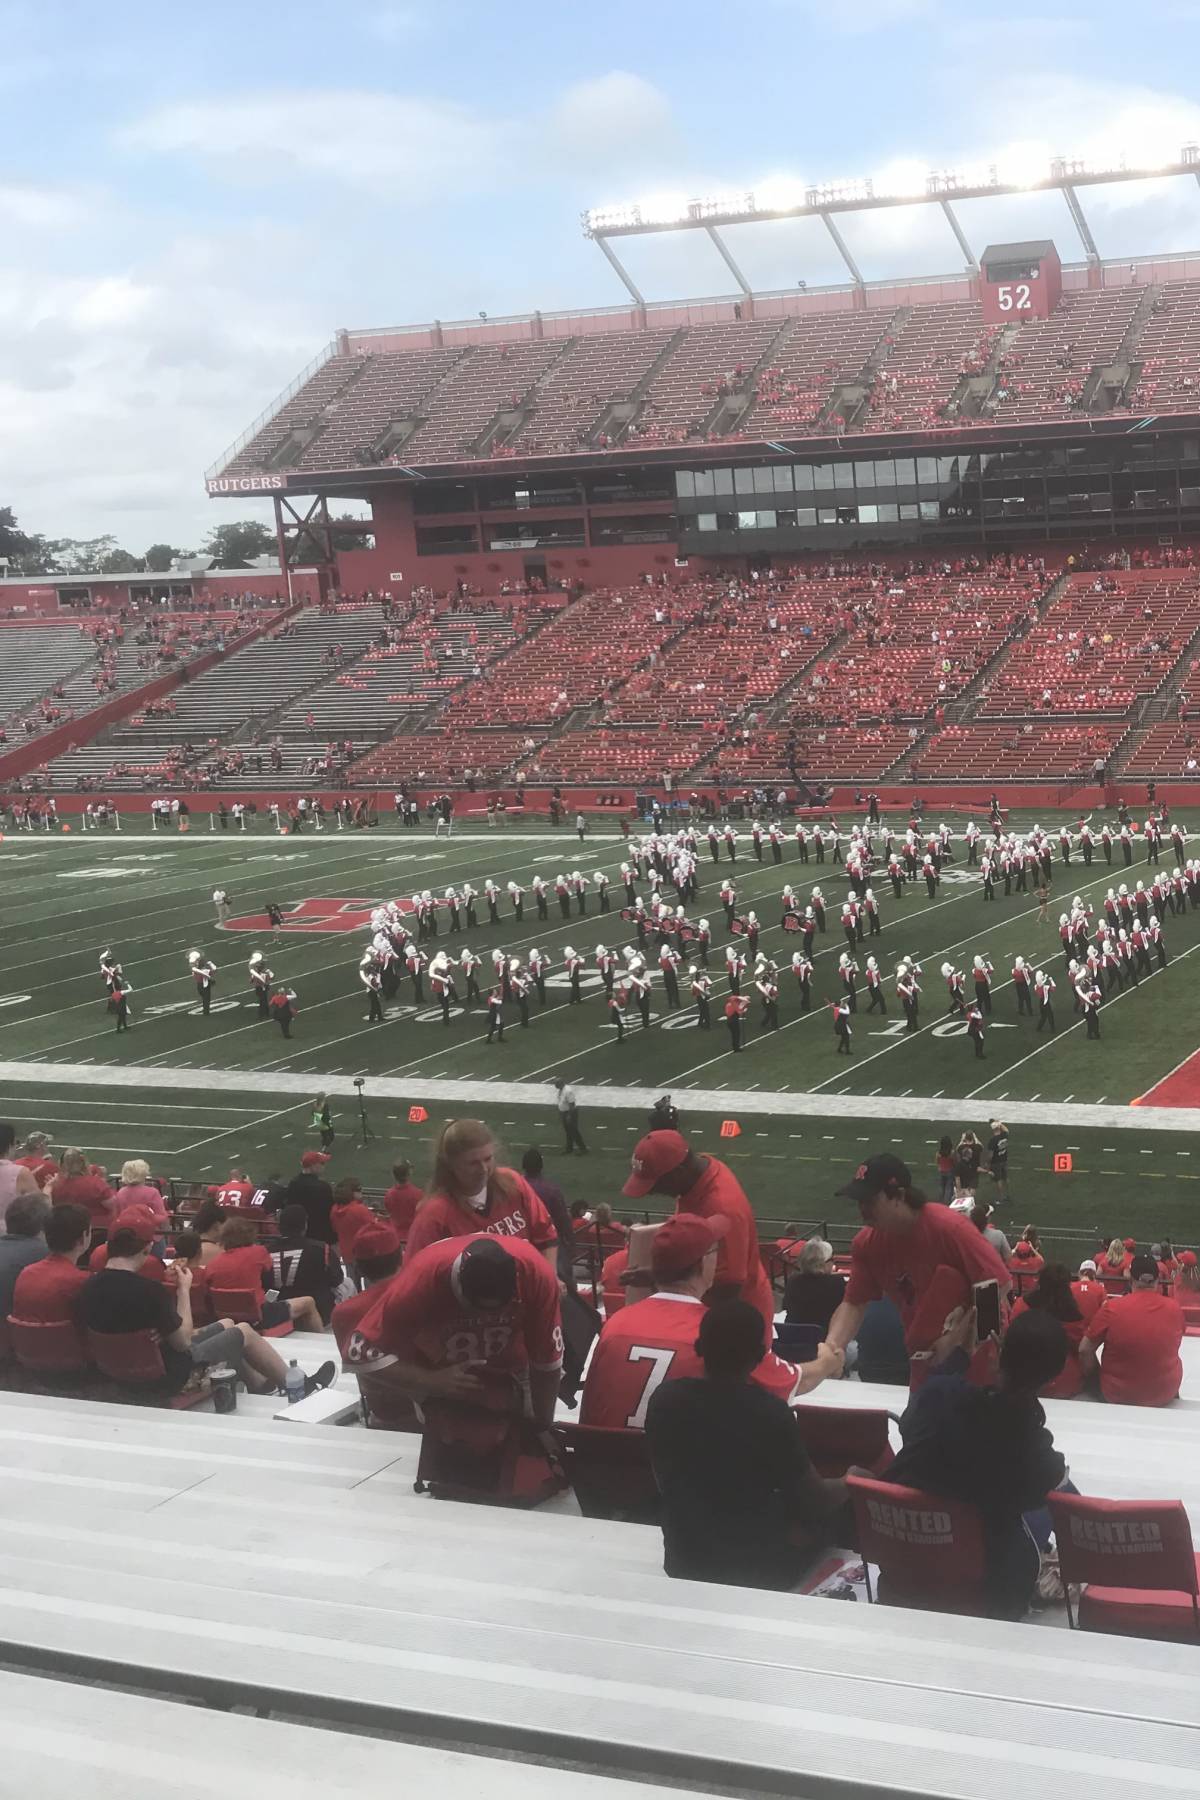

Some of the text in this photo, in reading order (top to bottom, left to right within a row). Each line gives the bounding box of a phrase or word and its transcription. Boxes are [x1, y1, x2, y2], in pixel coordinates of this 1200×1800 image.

[998, 285, 1032, 311] 52
[208, 476, 282, 492] RUTGERS
[868, 1019, 972, 1038] 10
[410, 1109, 421, 1120] 20
[724, 1122, 735, 1136] 10
[1058, 1156, 1068, 1170] G
[251, 1189, 269, 1206] 16
[627, 1345, 676, 1429] 7
[866, 1500, 952, 1533] RENTED
[1070, 1514, 1161, 1543] RENTED
